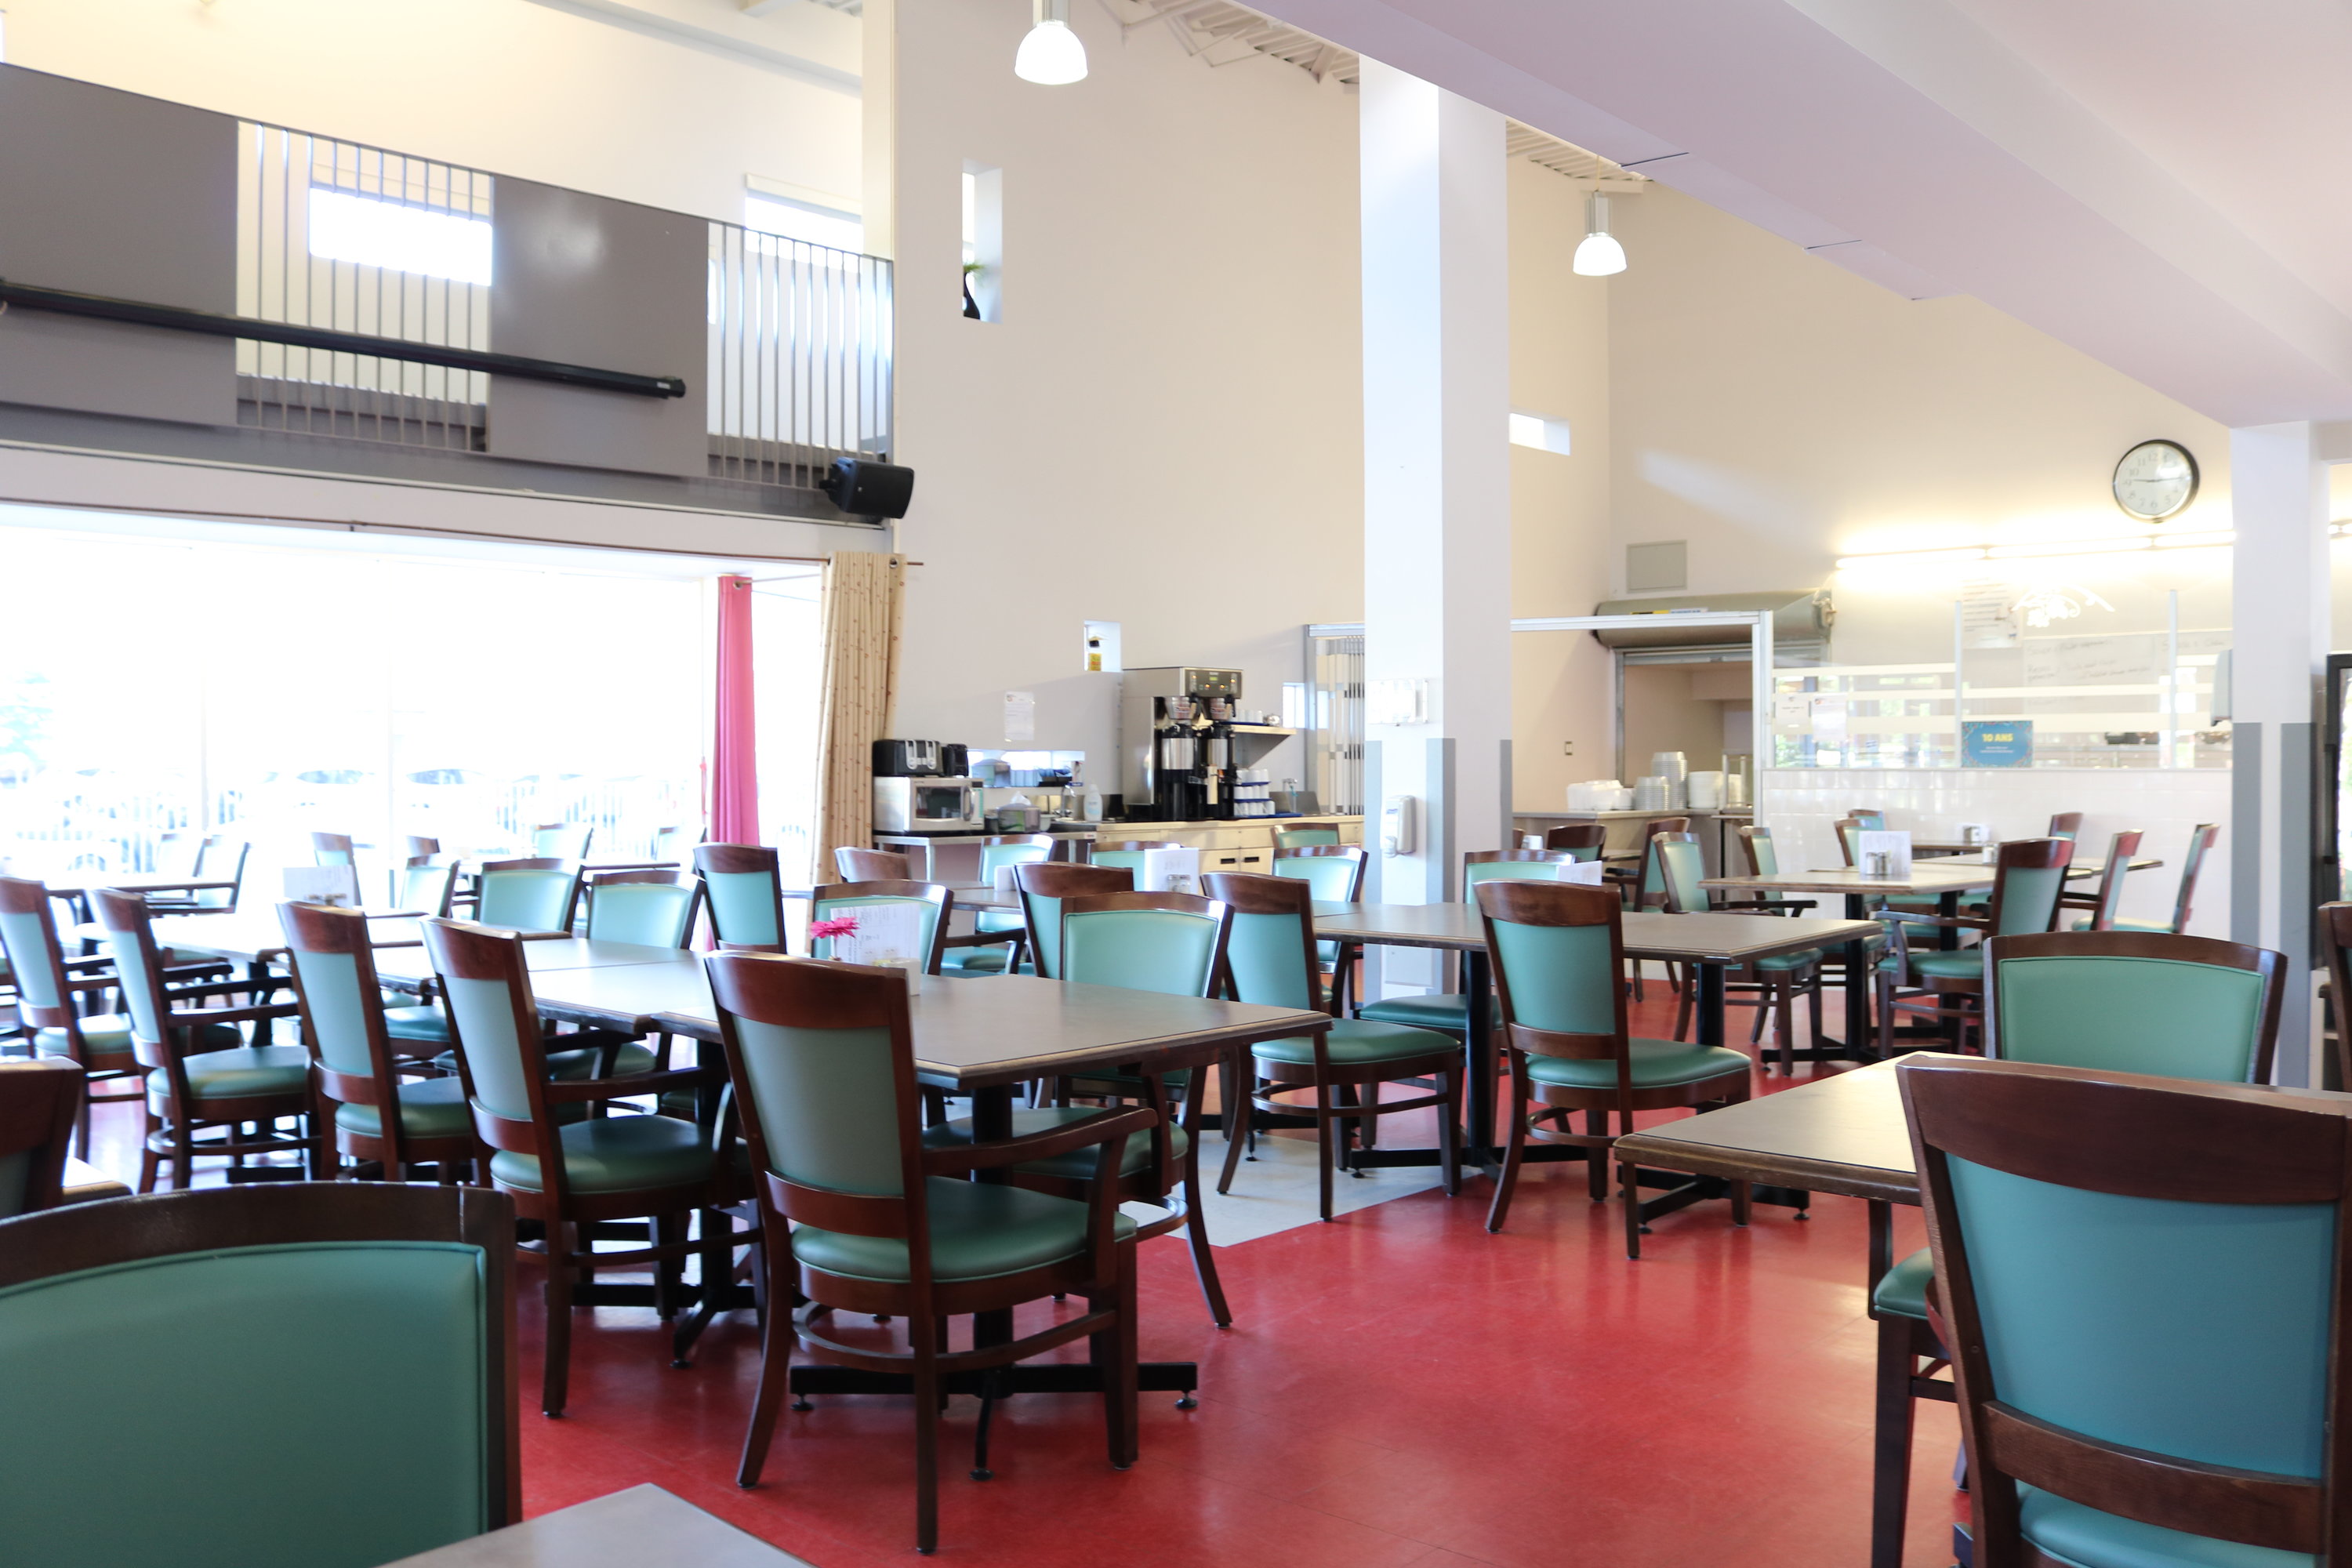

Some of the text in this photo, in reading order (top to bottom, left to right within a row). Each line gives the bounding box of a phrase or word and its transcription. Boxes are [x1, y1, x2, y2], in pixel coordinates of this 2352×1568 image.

[2148, 452, 2158, 462] 12
[1982, 733, 2013, 742] 10 ANS
